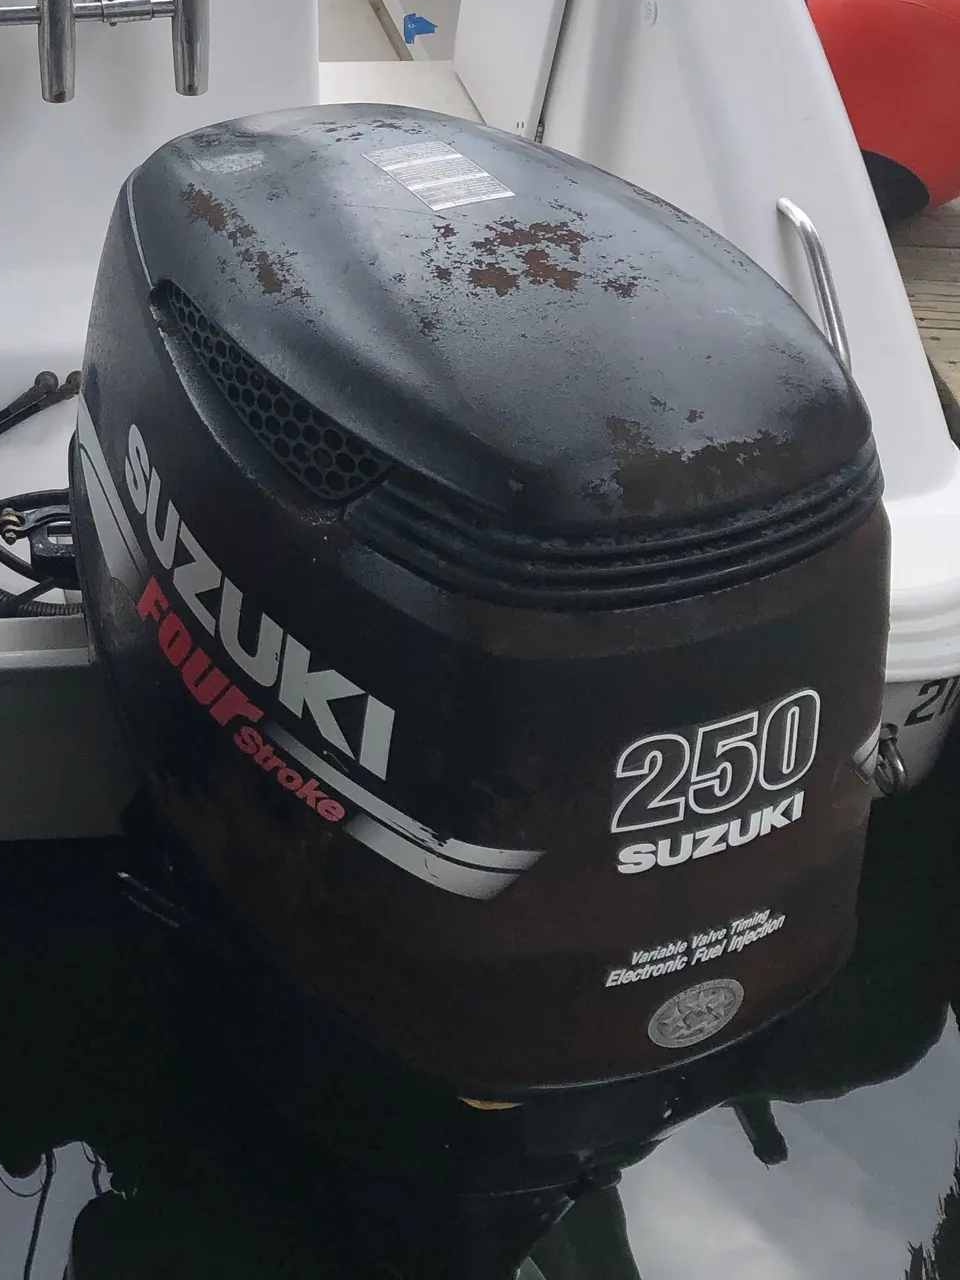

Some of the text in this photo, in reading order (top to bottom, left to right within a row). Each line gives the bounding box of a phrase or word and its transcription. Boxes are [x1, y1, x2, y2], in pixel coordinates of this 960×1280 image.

[125, 423, 395, 782] SUZUKI
[611, 689, 821, 834] 250
[617, 790, 805, 874] SUZUKI
[605, 914, 786, 988] Electronic Fuel Injection
[631, 908, 771, 966] Variable Valve Timing
